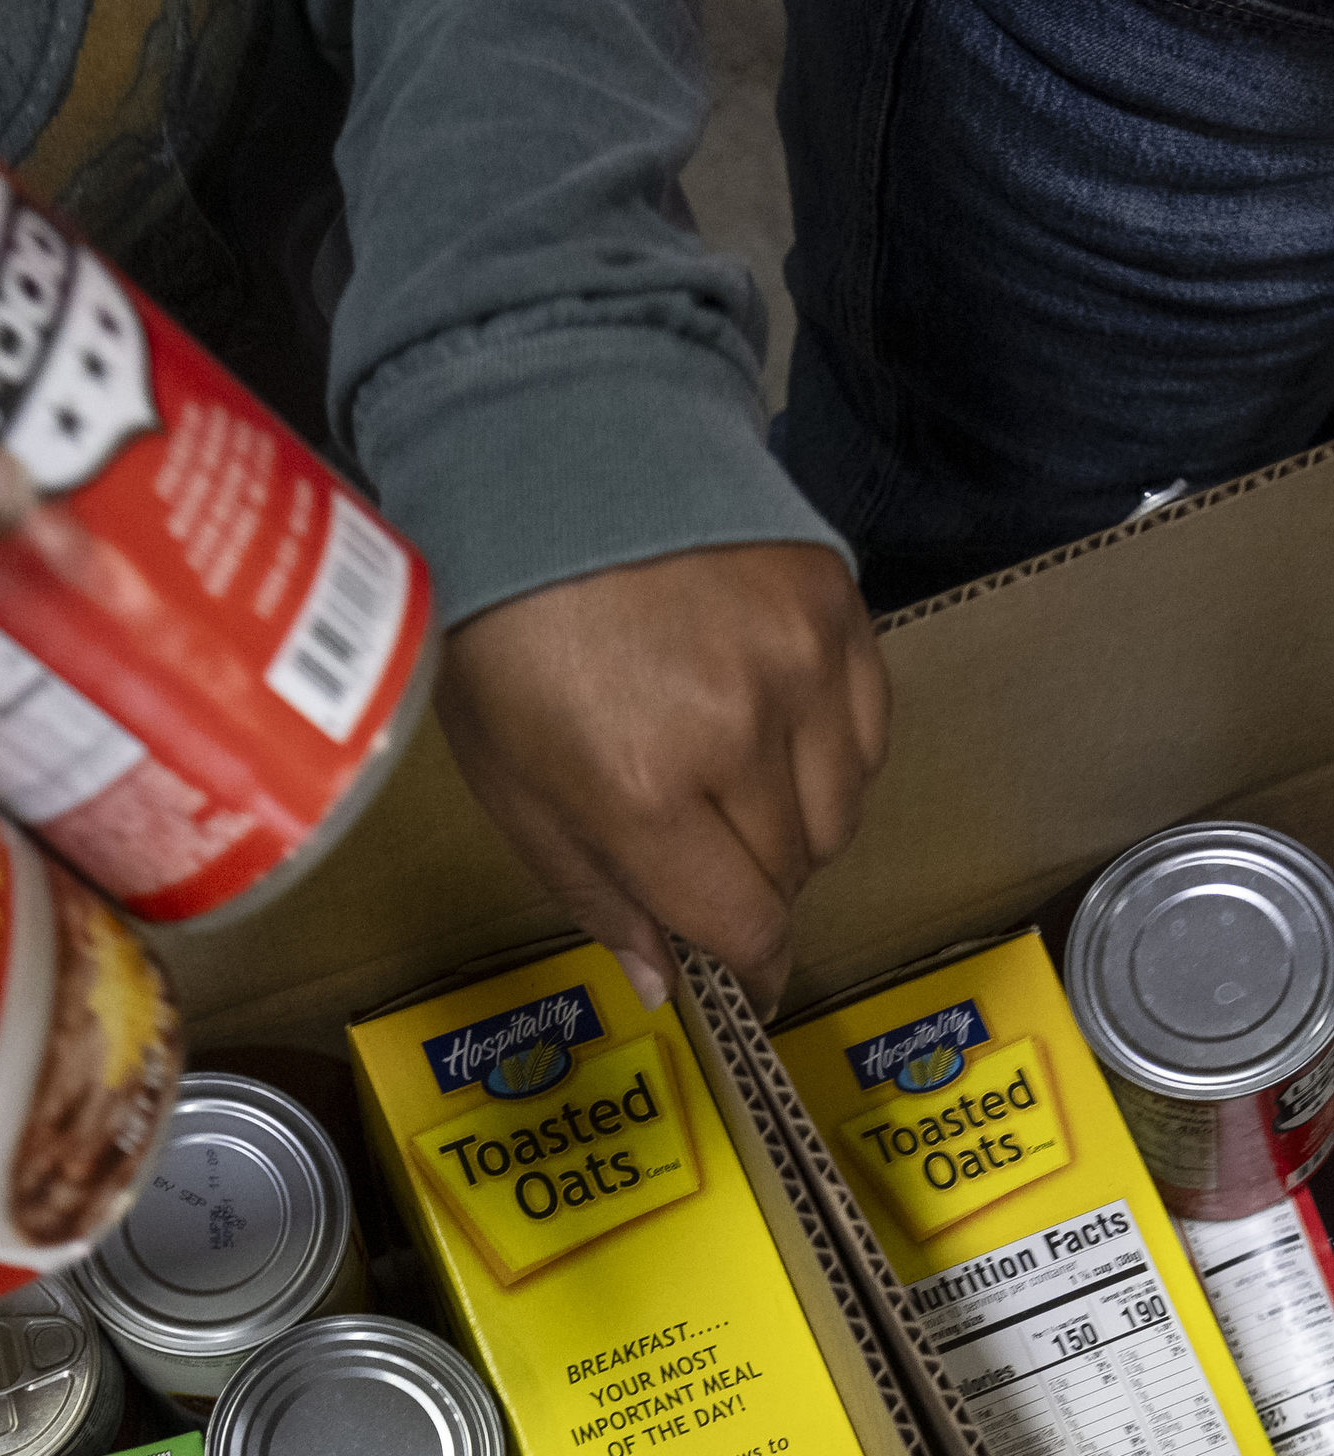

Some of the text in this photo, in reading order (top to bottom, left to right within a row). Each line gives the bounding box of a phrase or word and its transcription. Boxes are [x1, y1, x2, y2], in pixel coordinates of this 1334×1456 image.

[434, 990, 592, 1085] Hospitality
[854, 1002, 983, 1084] Hospitality
[437, 1071, 658, 1191] Toasted
[858, 1067, 1038, 1169] Toasted
[509, 1137, 682, 1224] Oats Cereal
[918, 1123, 1024, 1193] Oats
[1042, 1204, 1131, 1261] Facts
[1049, 1293, 1168, 1359] 150 190
[569, 1358, 763, 1448] IMPORTANT MEAL
[589, 1344, 723, 1410] YOUR MOST
[955, 1359, 1017, 1398] alories
[641, 1414, 690, 1447] THE
[692, 1392, 747, 1429] DAY!
[766, 1433, 790, 1455] to
